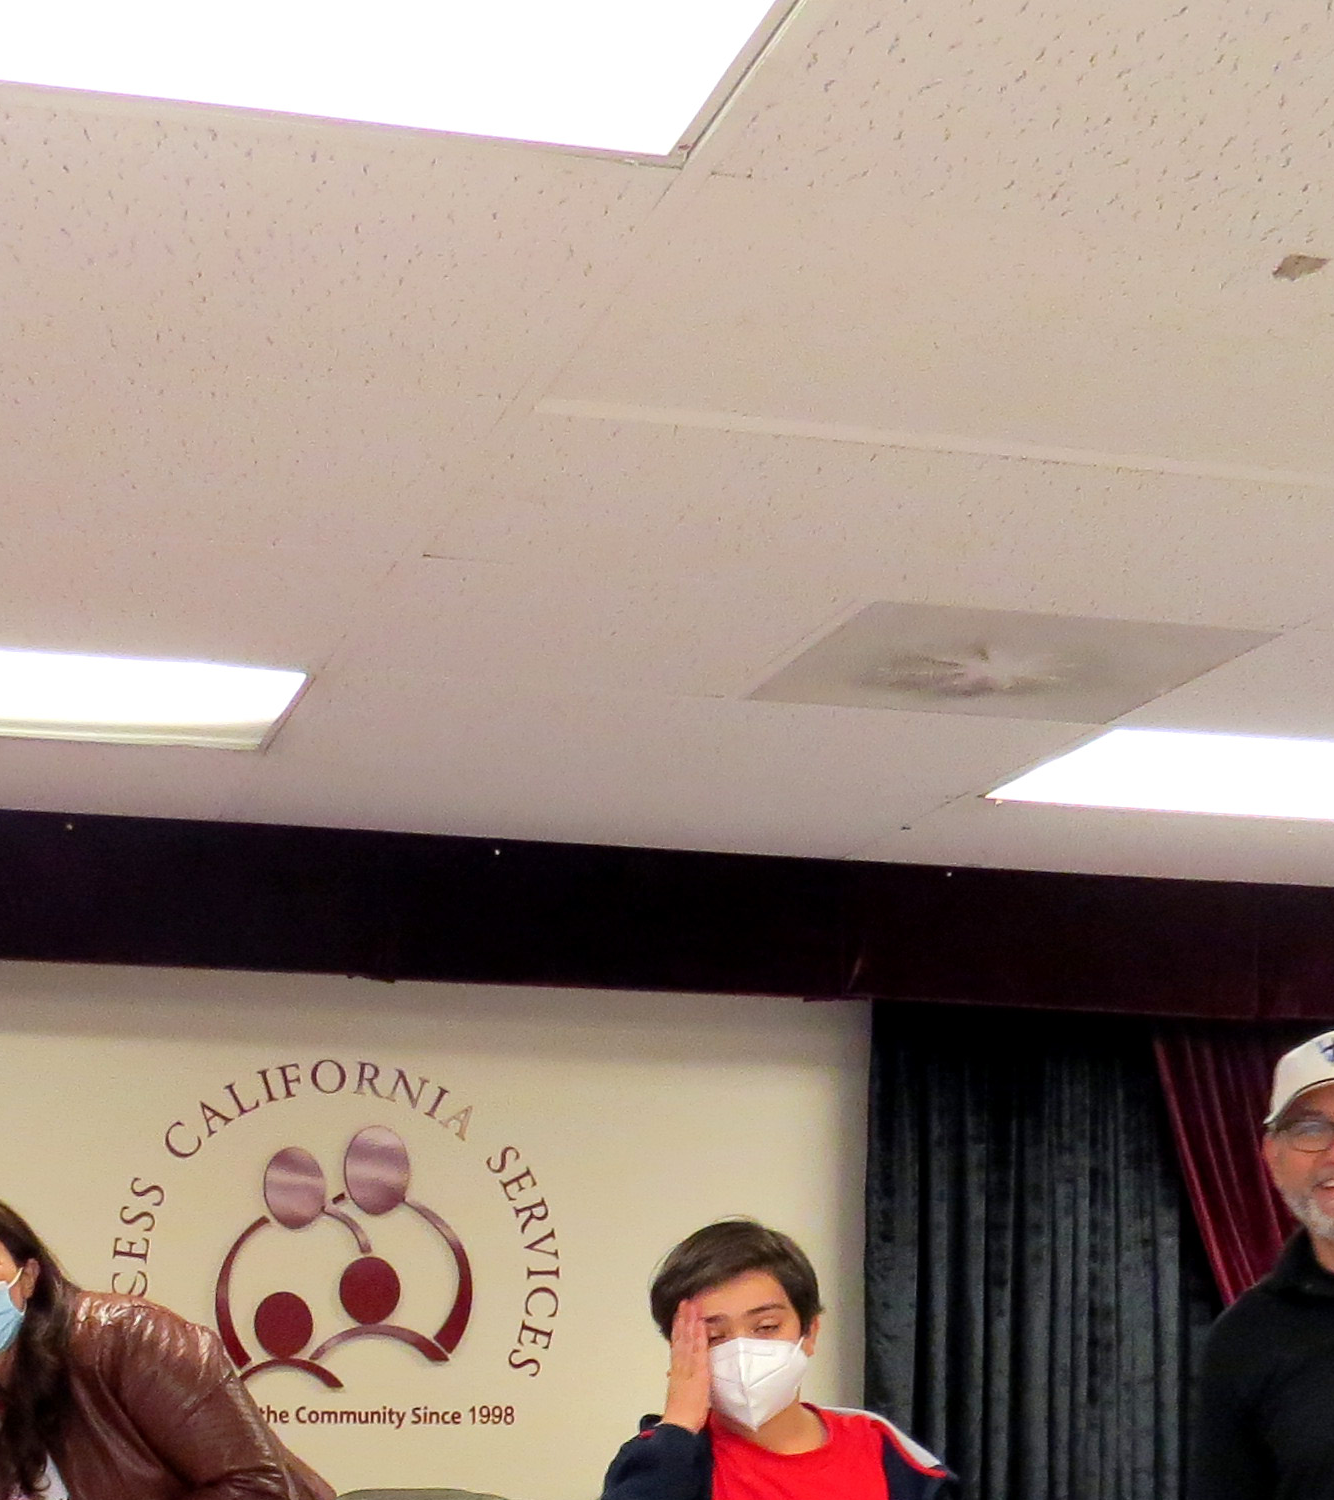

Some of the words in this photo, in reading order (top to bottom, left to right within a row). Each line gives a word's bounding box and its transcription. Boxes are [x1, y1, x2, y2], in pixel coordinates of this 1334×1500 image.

[111, 1176, 166, 1298] CESS
[164, 1058, 473, 1160] CALIFORNIA
[485, 1144, 561, 1378] SERVICES
[296, 1405, 405, 1429] Community
[411, 1405, 462, 1425] Since
[468, 1405, 516, 1425] 1998
